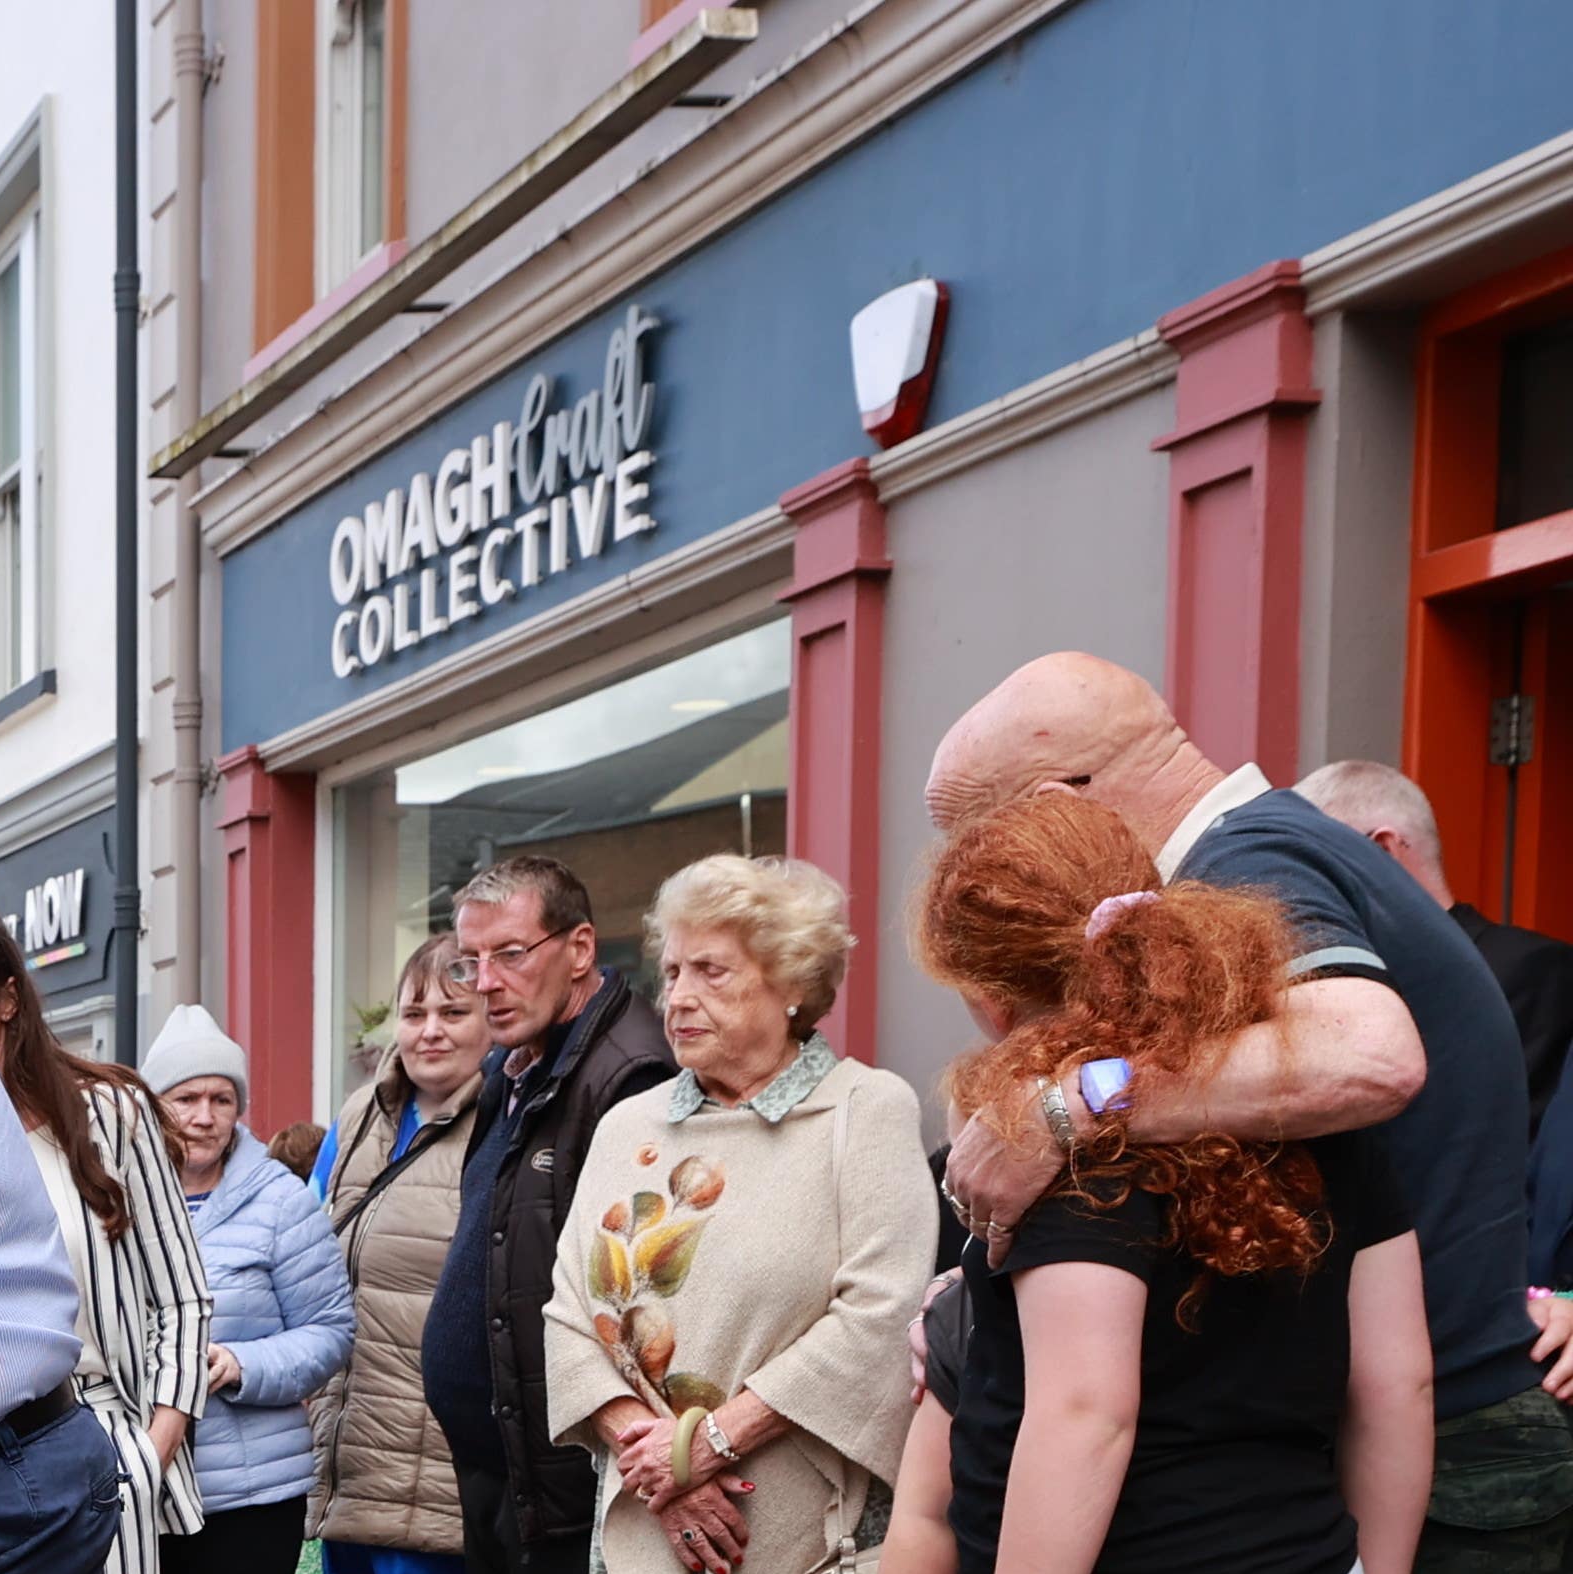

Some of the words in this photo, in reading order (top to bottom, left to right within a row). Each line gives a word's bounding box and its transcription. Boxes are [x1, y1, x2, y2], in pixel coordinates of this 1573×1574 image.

[329, 420, 512, 606] OMAGH
[509, 303, 661, 505] Craft
[331, 449, 657, 679] COLLECTIVE
[24, 867, 85, 952] NOW
